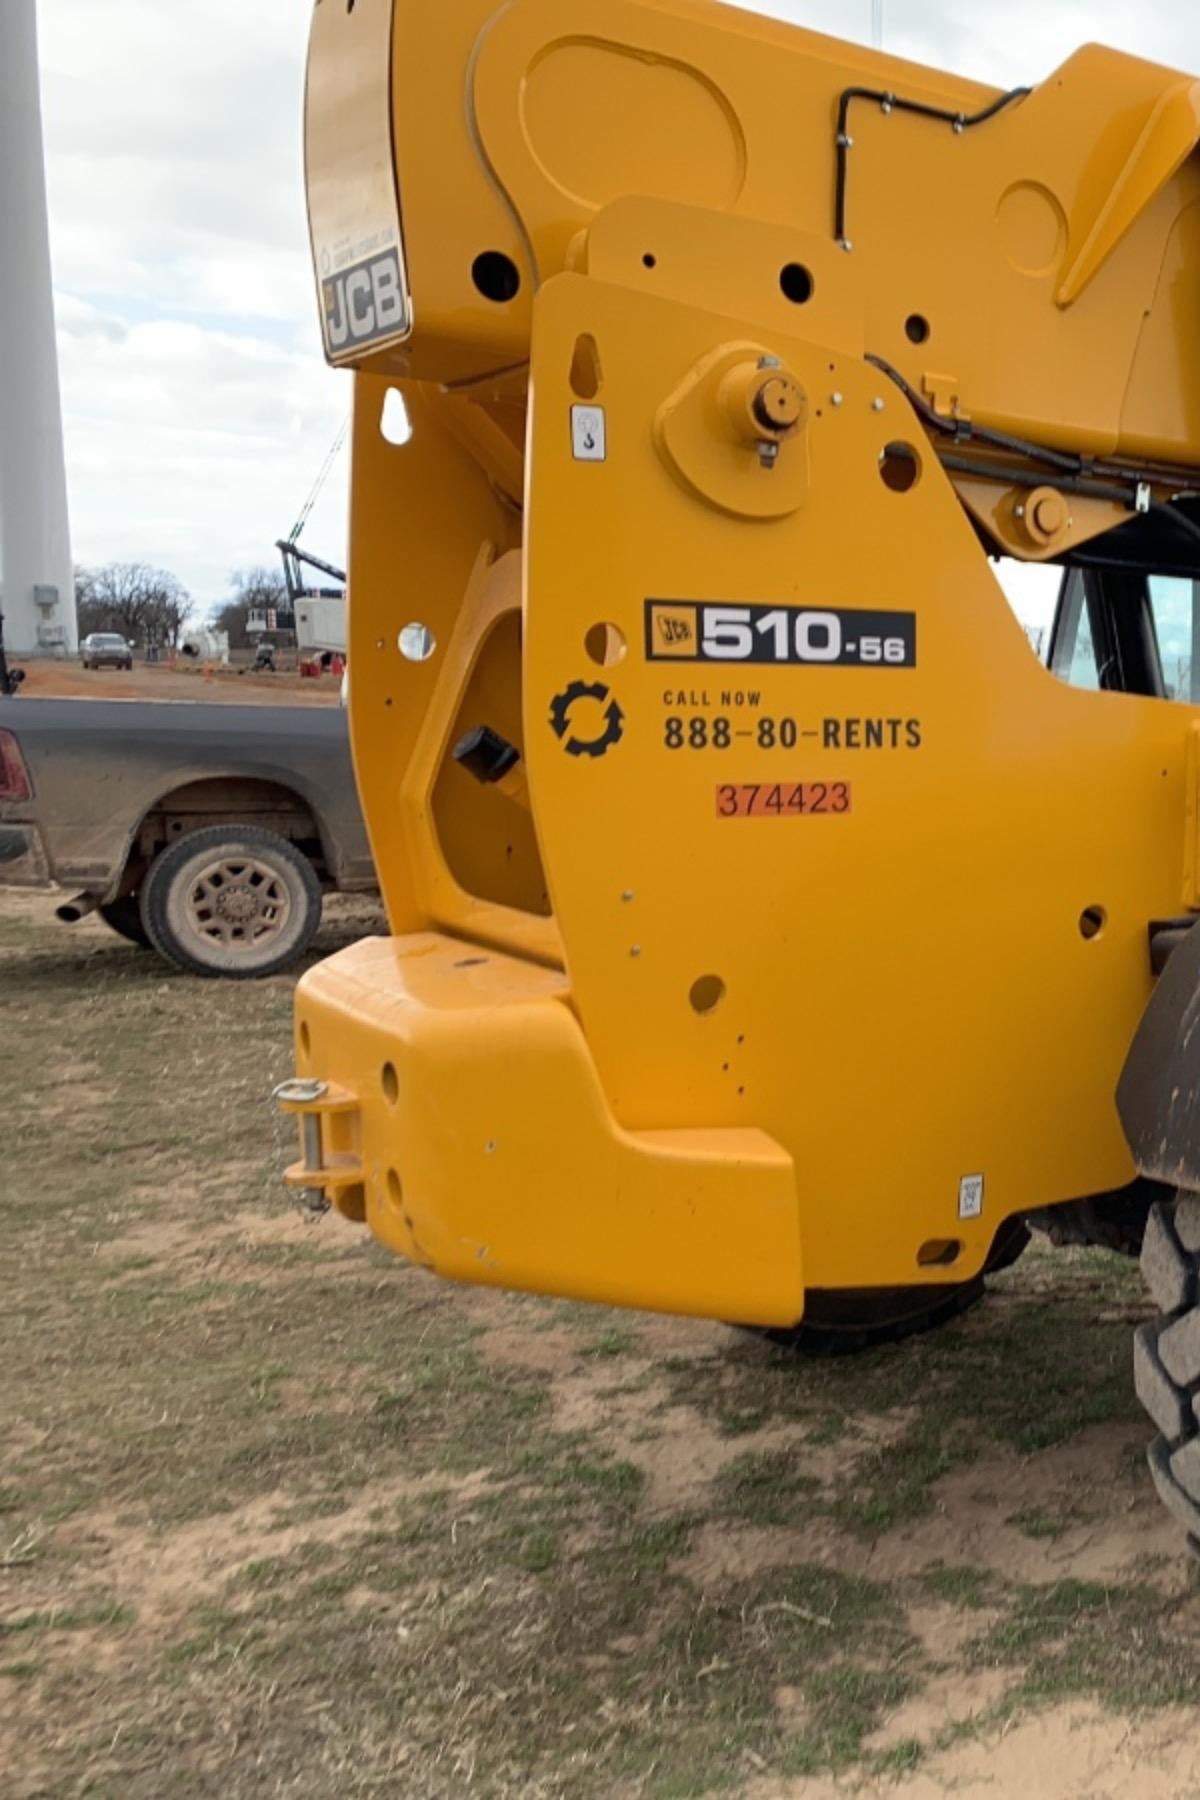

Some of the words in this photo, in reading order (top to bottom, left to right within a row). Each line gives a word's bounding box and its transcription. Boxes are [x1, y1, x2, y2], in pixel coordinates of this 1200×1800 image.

[328, 257, 402, 345] JCB
[701, 607, 905, 662] 510-56
[663, 691, 711, 706] CALL
[721, 692, 761, 707] NOW
[664, 717, 921, 749] 888-80-RENTS
[719, 782, 849, 817] 374423
